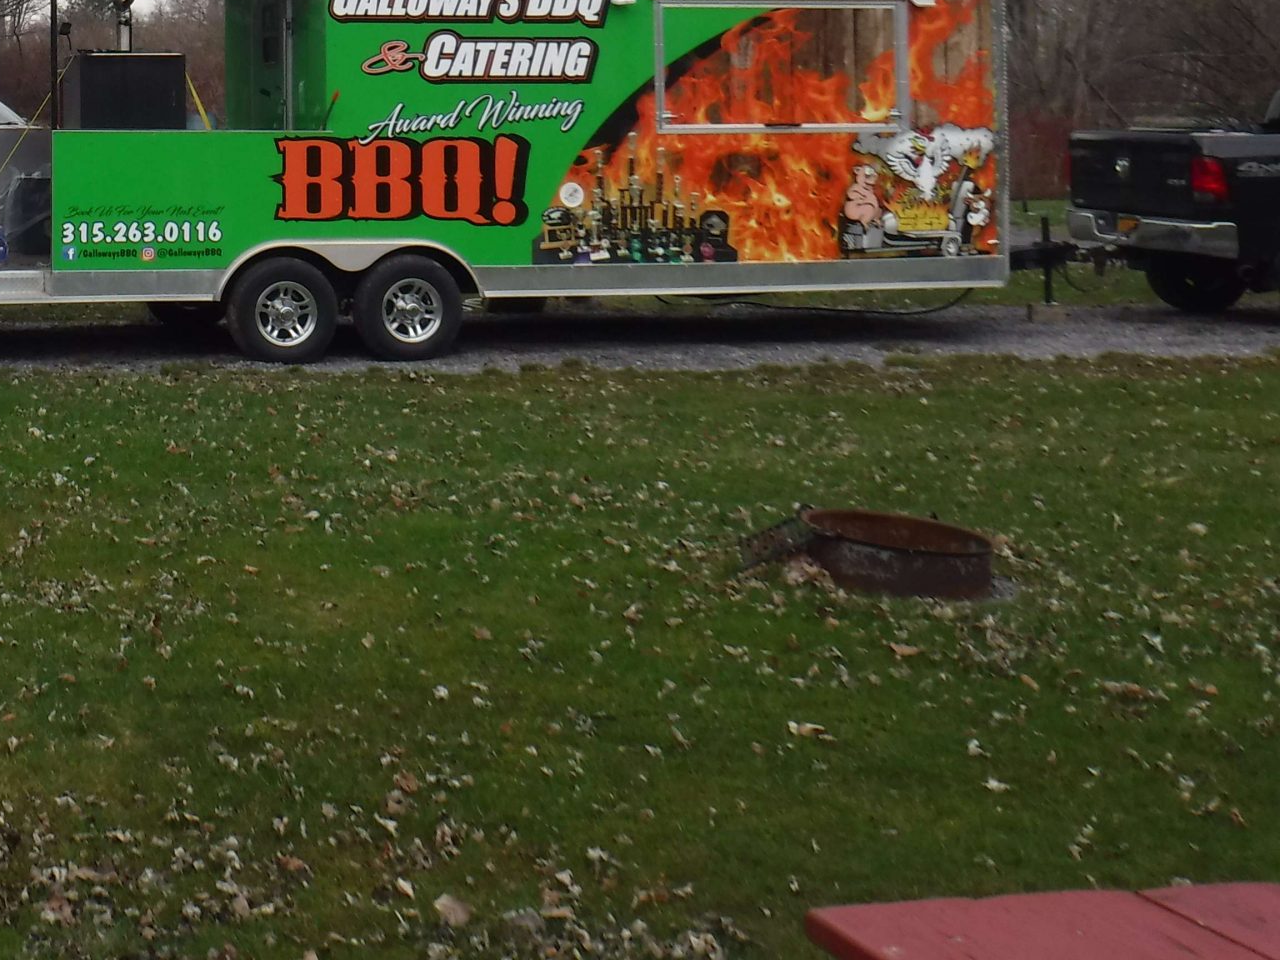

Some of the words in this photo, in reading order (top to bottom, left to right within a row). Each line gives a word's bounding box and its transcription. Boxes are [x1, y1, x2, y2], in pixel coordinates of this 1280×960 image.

[362, 40, 425, 74] &
[423, 34, 593, 78] CATERING
[358, 101, 467, 144] Award
[465, 90, 584, 132] Winning
[274, 134, 523, 226] BBQ!
[61, 220, 223, 244] 315.263.0116
